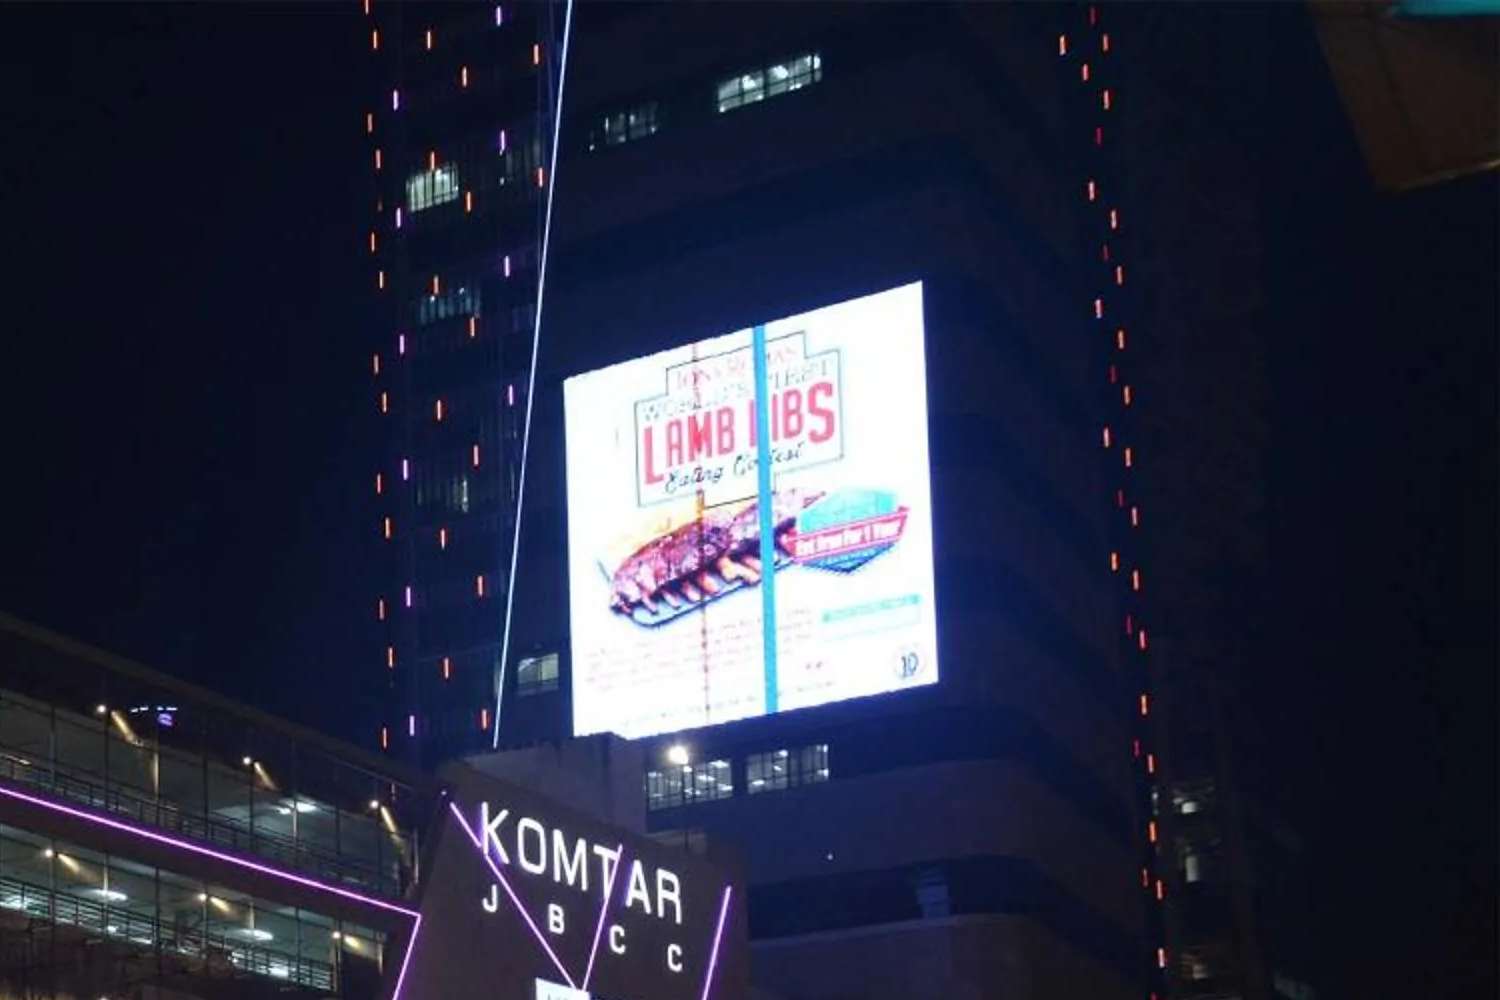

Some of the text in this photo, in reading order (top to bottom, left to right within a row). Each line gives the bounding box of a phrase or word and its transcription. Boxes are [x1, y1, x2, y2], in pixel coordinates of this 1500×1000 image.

[644, 405, 735, 485] LAMB
[733, 441, 806, 478] Cotest
[480, 800, 682, 924] KOMTAR
